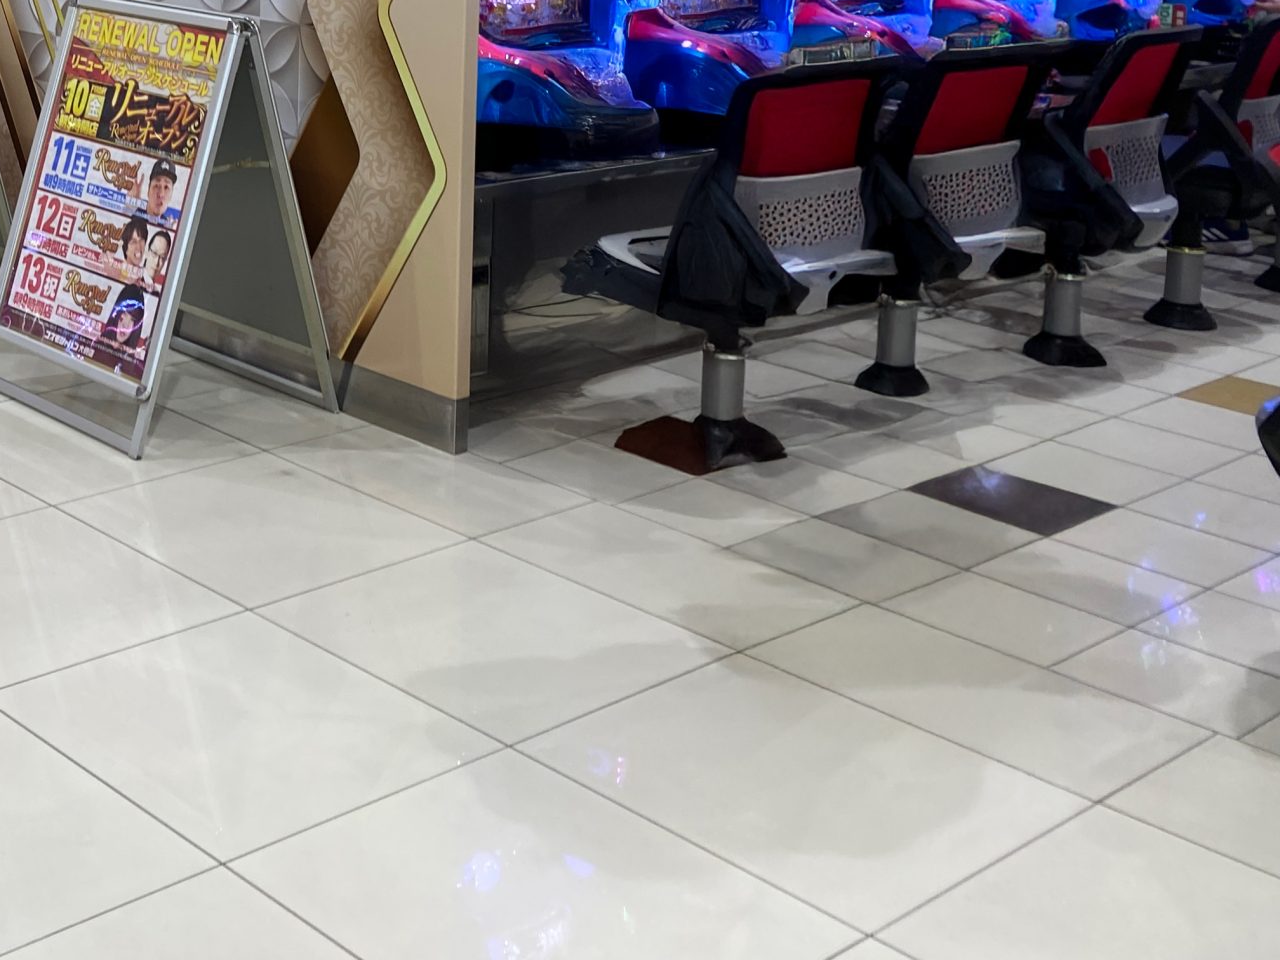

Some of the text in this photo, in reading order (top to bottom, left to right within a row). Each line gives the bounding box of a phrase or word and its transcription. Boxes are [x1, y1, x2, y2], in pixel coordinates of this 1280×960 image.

[77, 15, 223, 63] RENEWAL OPEN
[63, 79, 90, 115] 10
[107, 78, 200, 139] リニューアル
[49, 137, 89, 178] 11 土
[136, 121, 187, 153] オープン
[44, 173, 83, 196] 朝9時開店
[33, 195, 73, 237] 12 日
[17, 253, 46, 294] 13
